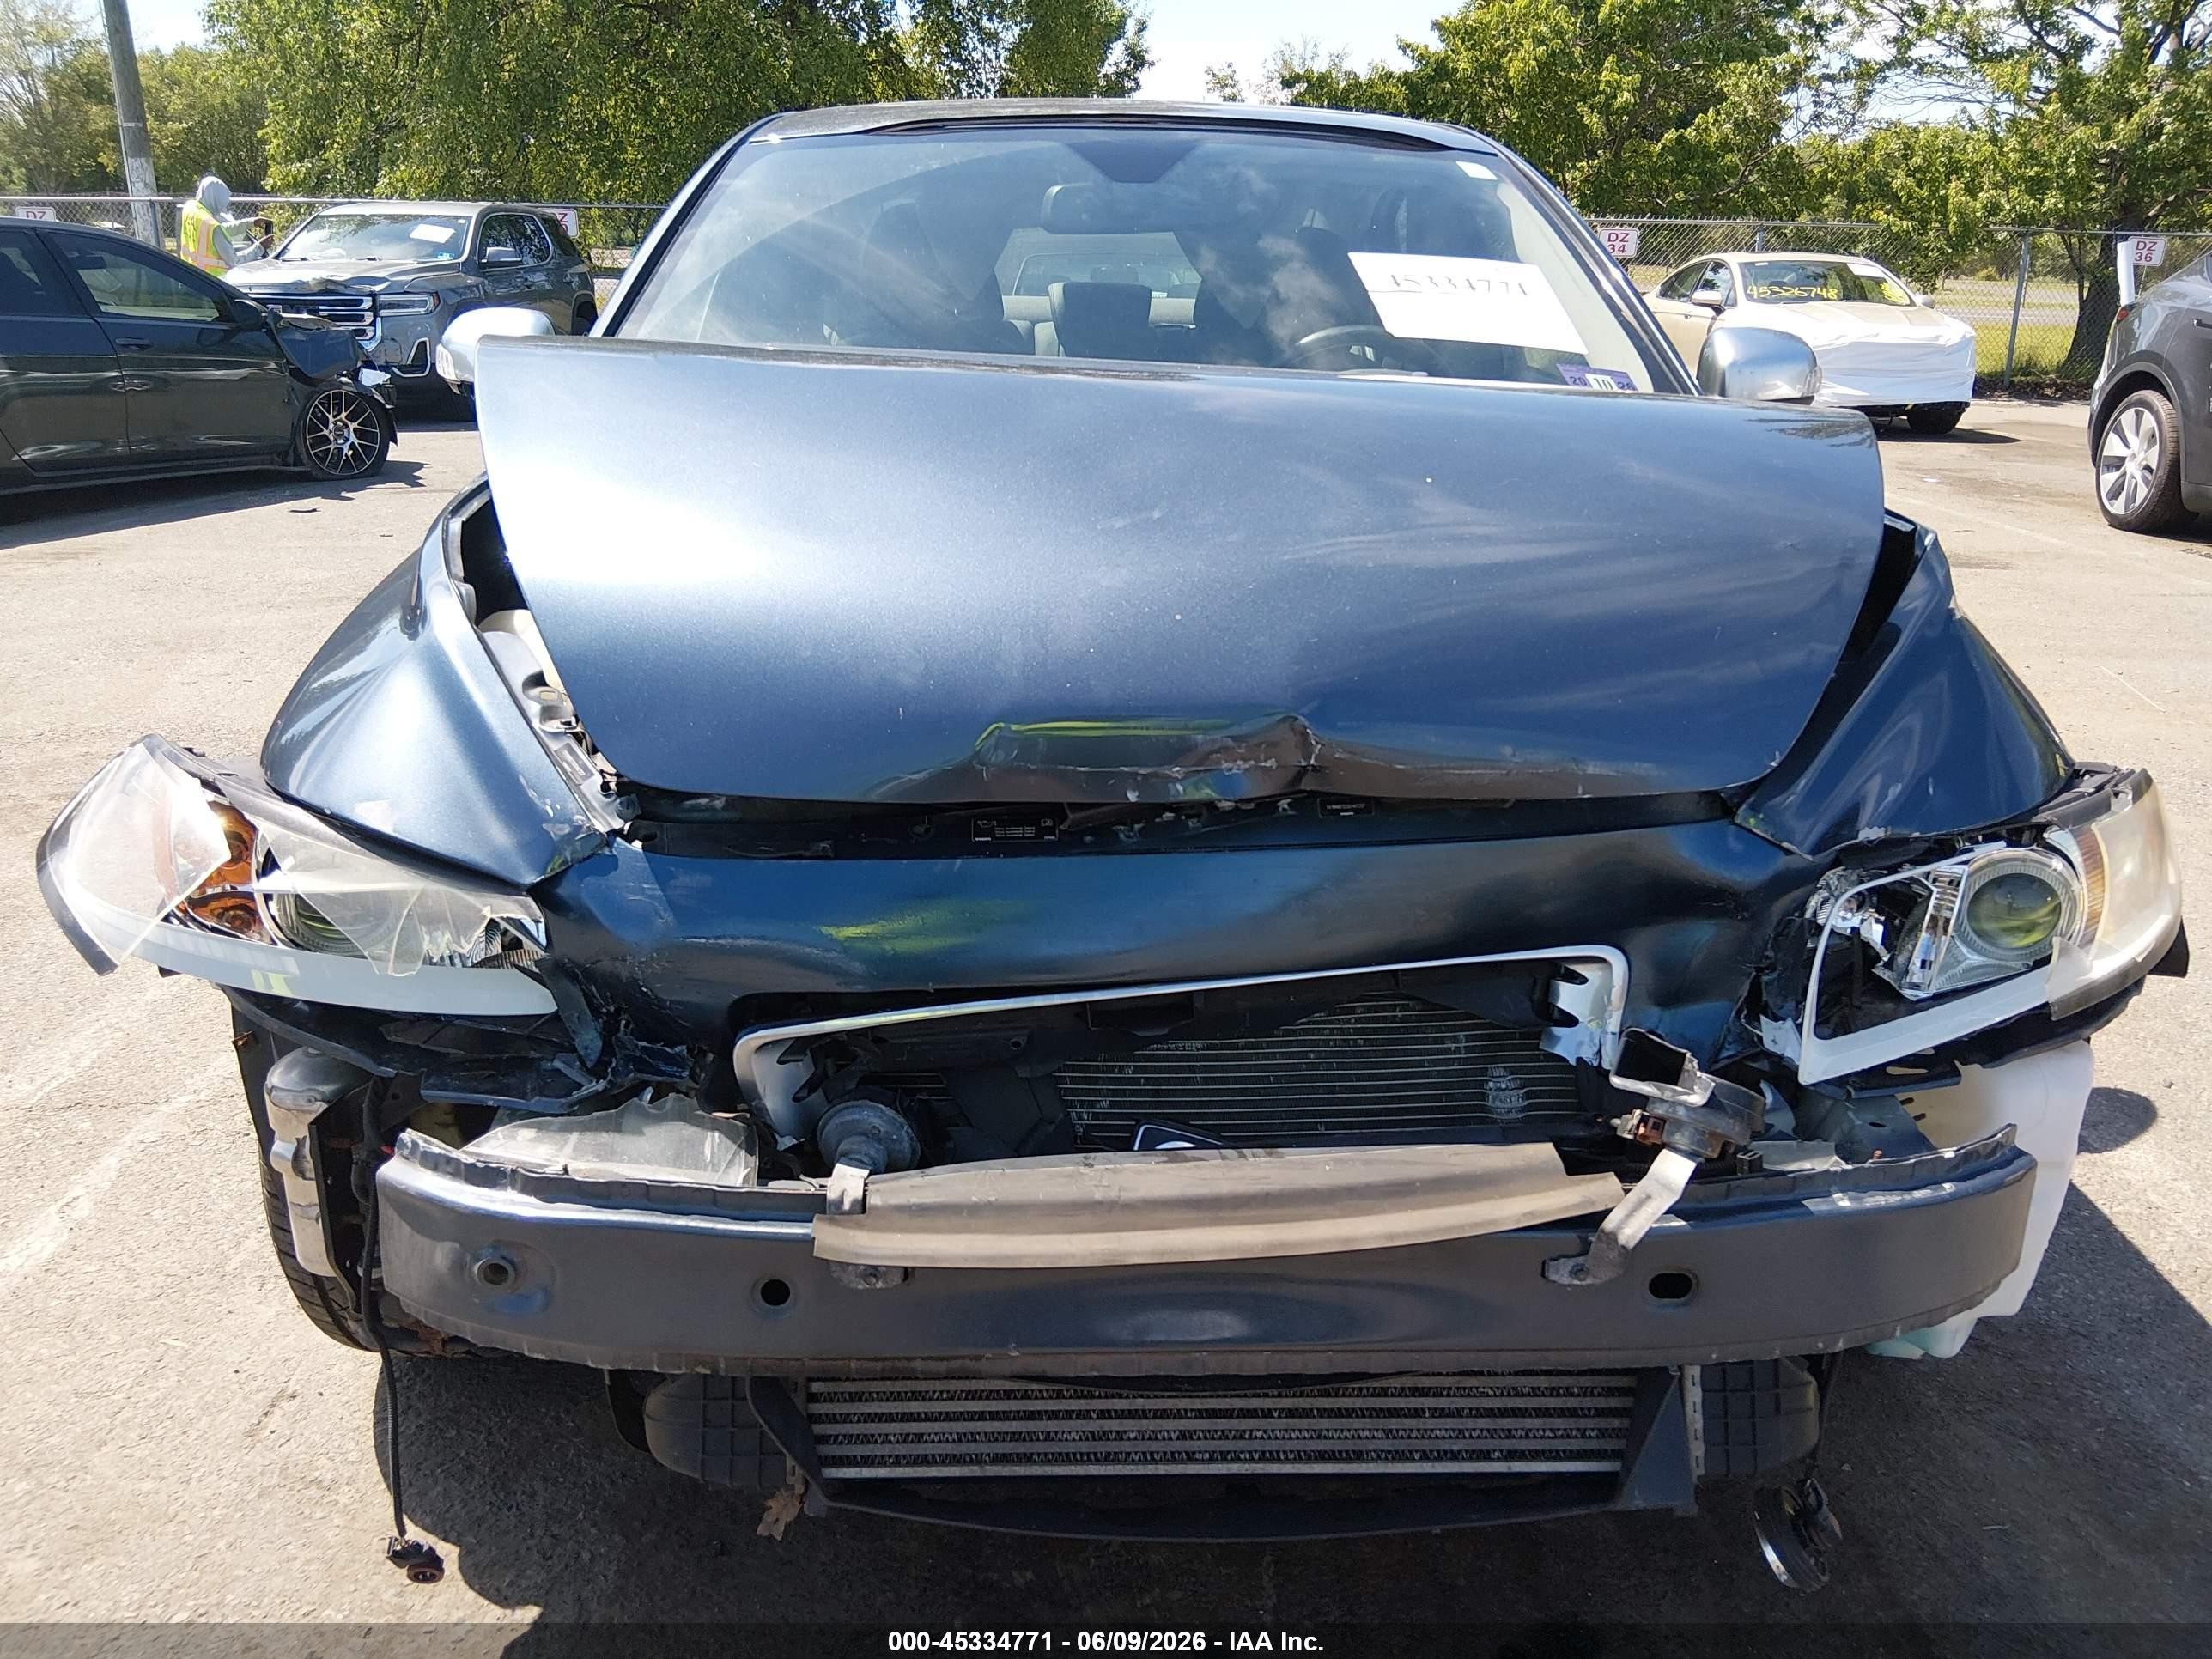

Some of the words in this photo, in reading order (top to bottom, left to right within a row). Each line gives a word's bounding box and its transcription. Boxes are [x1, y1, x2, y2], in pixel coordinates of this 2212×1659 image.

[1607, 232, 1630, 243] DZ
[1607, 244, 1626, 254] 34
[2136, 240, 2158, 252] DZ
[2134, 252, 2153, 263] 36
[1747, 285, 1839, 300] 45326748
[1569, 376, 1588, 386] 20
